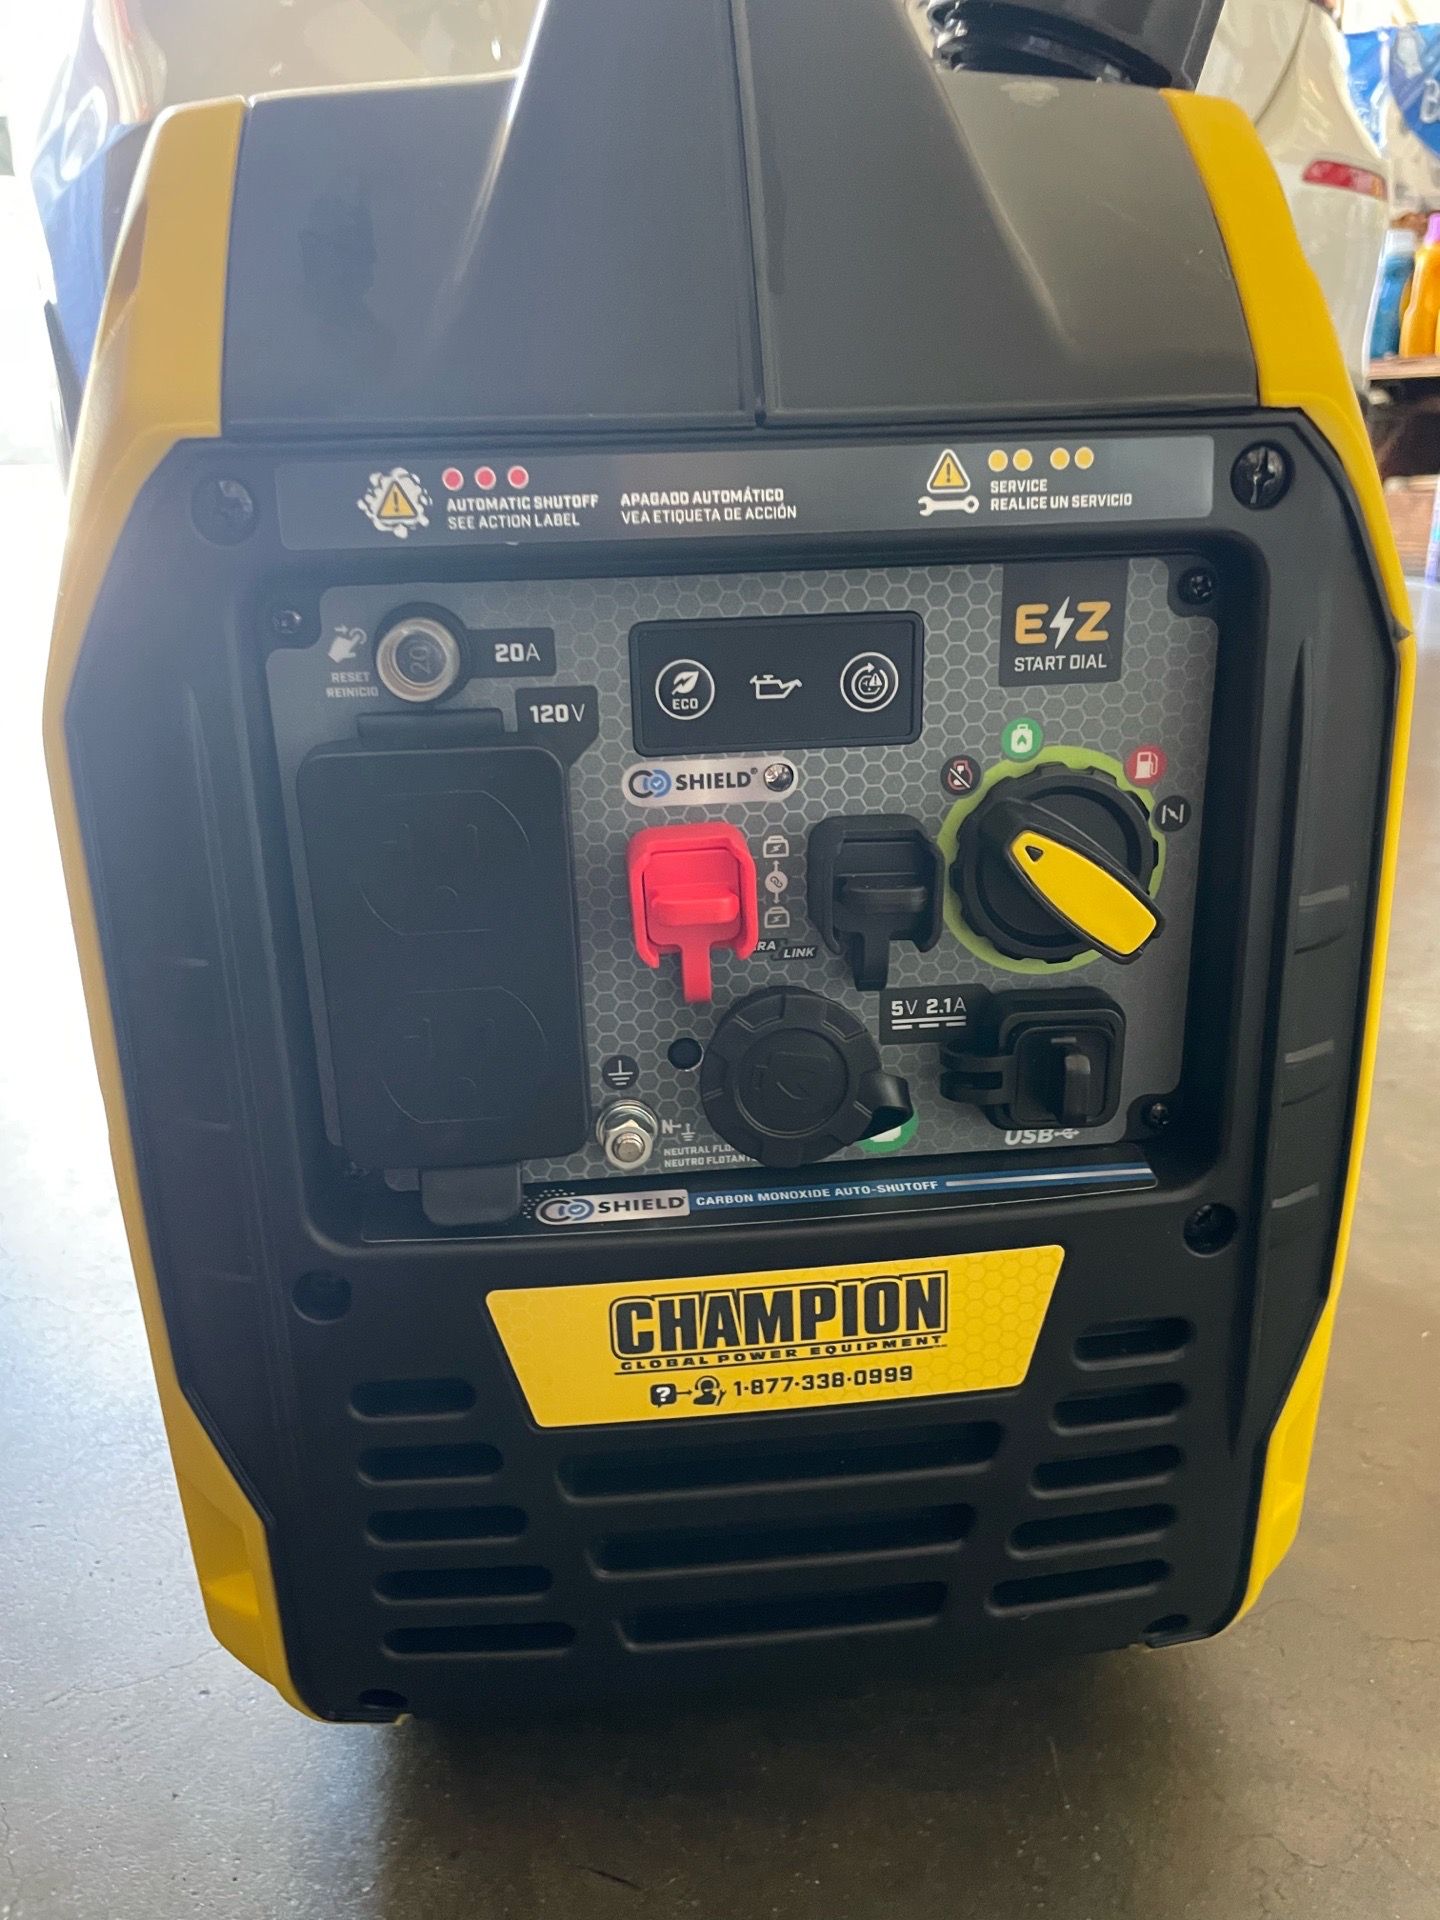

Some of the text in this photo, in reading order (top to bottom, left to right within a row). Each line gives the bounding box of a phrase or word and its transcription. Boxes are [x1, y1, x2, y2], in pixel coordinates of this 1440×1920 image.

[990, 478, 1048, 494] SERVICE
[447, 494, 599, 512] AUTOMATIC SHUTOFF
[620, 486, 785, 507] APAGADO AUTOMÁTICO
[990, 493, 1133, 511] REALICE UN SERVICIO
[448, 512, 580, 530] SEE ACTION LABEL
[621, 503, 797, 525] VEA ETIQUETA DE ACCIÓN
[1014, 653, 1108, 672] START DIAL
[330, 671, 371, 684] RESET
[325, 686, 379, 698] REINICIO
[672, 697, 699, 710] ECO
[783, 947, 816, 958] LINK
[891, 996, 967, 1016] 5V 2.1A
[1005, 1129, 1055, 1146] USB
[663, 1145, 711, 1157] NEUTRAL
[664, 1156, 705, 1168] NEUTRO
[696, 1181, 939, 1206] CARBON MONOXIDE AUTO-SHUTOFF
[613, 1274, 945, 1357] CHAMPION
[620, 1335, 942, 1371] GLOBAL POWER EQUIPMENT
